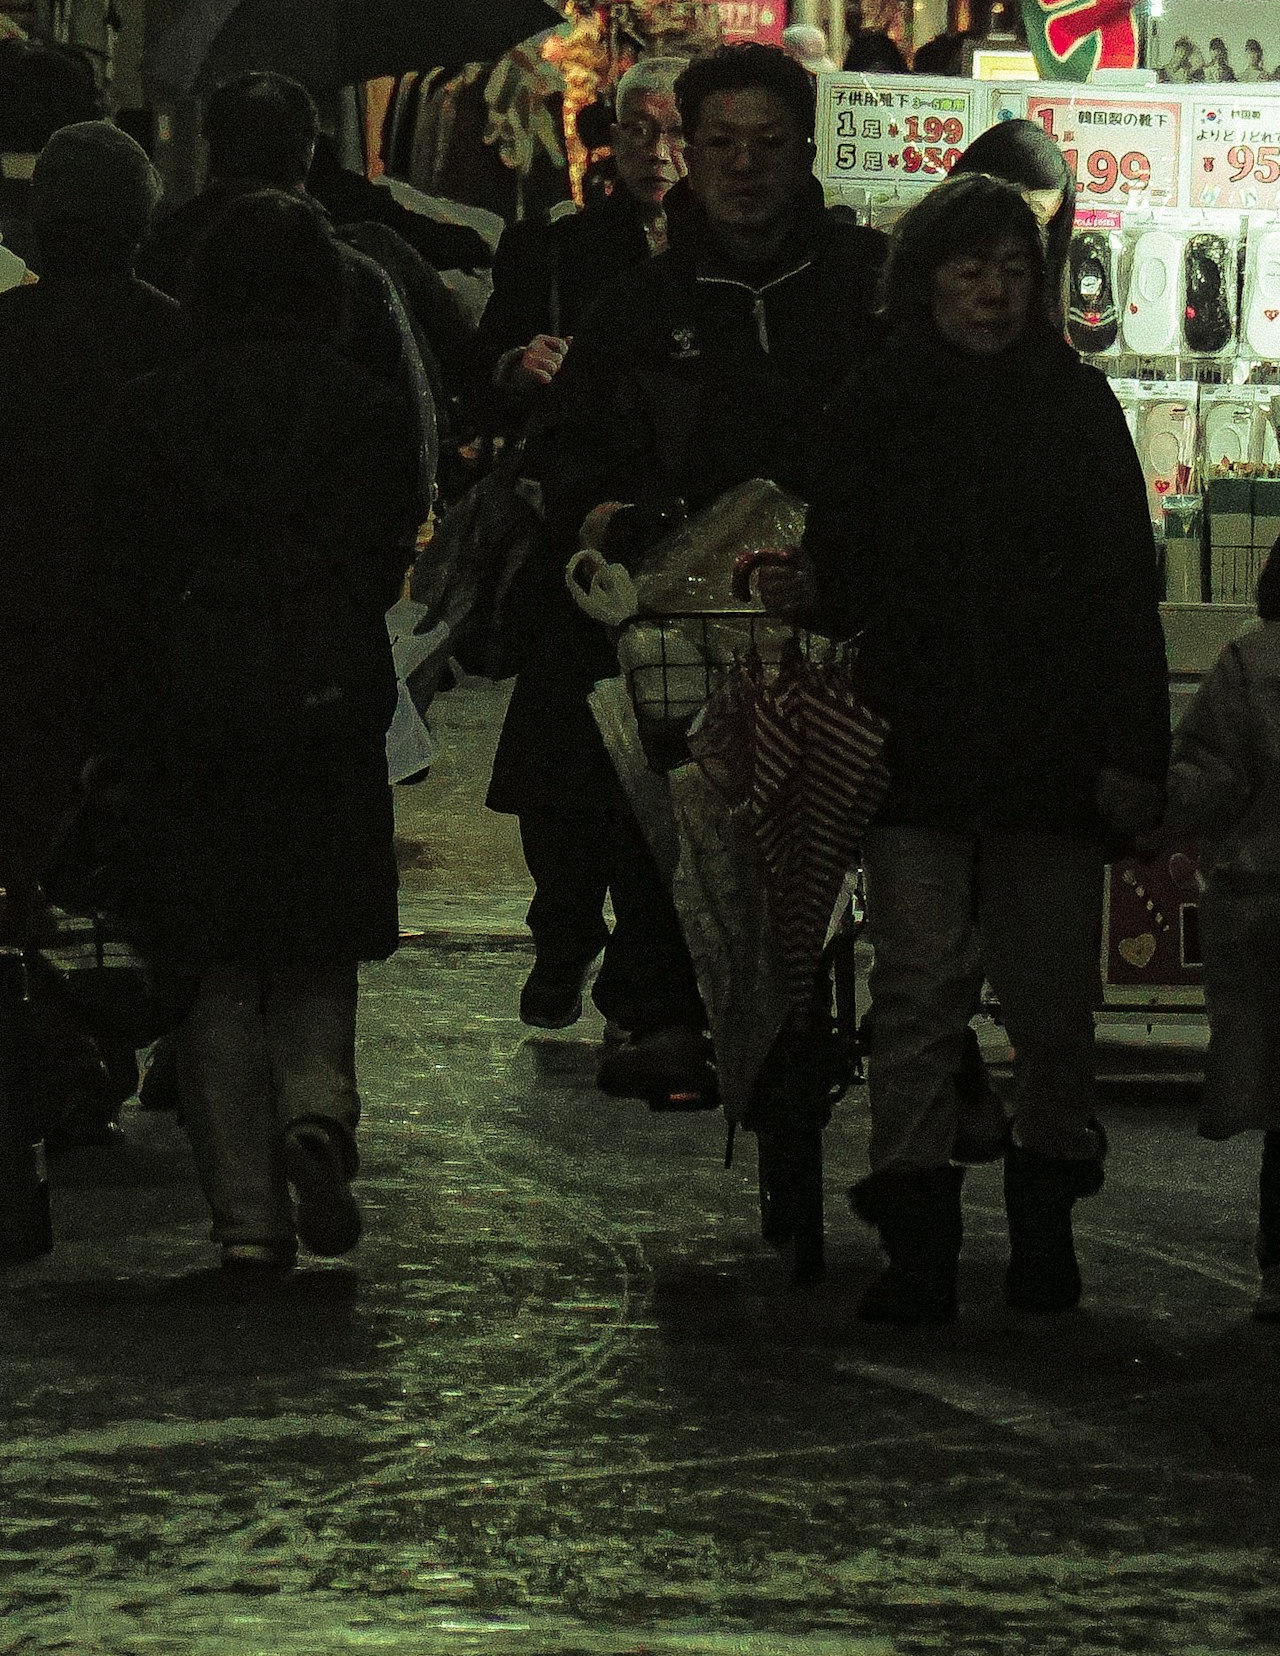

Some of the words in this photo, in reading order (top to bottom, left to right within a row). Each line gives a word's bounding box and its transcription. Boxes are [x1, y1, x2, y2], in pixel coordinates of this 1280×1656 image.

[1078, 111, 1168, 128] 韓国製の靴下
